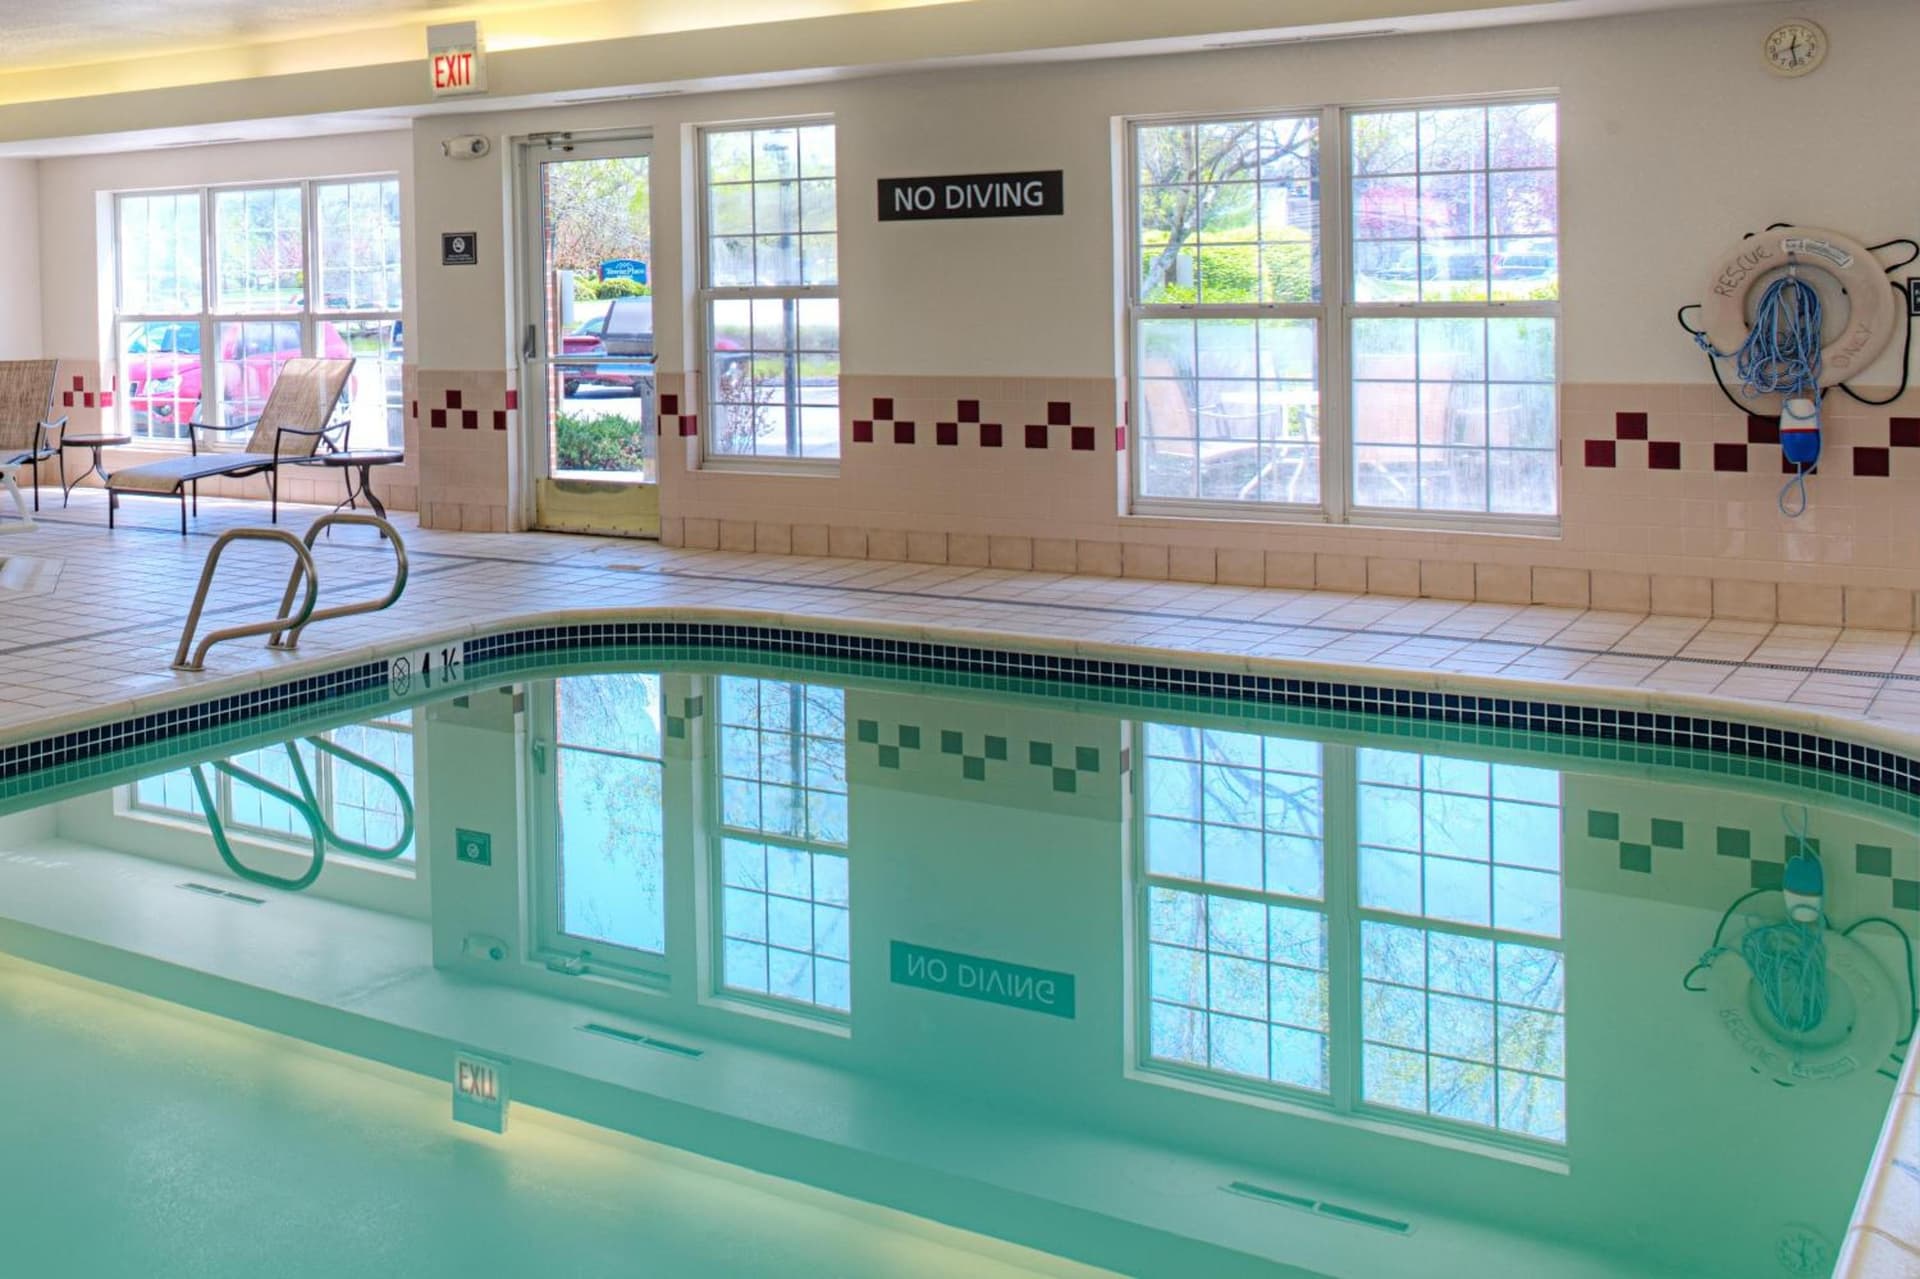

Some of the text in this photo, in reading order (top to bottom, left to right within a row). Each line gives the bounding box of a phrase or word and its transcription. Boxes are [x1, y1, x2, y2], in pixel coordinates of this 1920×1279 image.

[434, 53, 472, 88] EXIT
[894, 180, 1044, 212] NO DIVING
[1713, 246, 1774, 298] RESCUE
